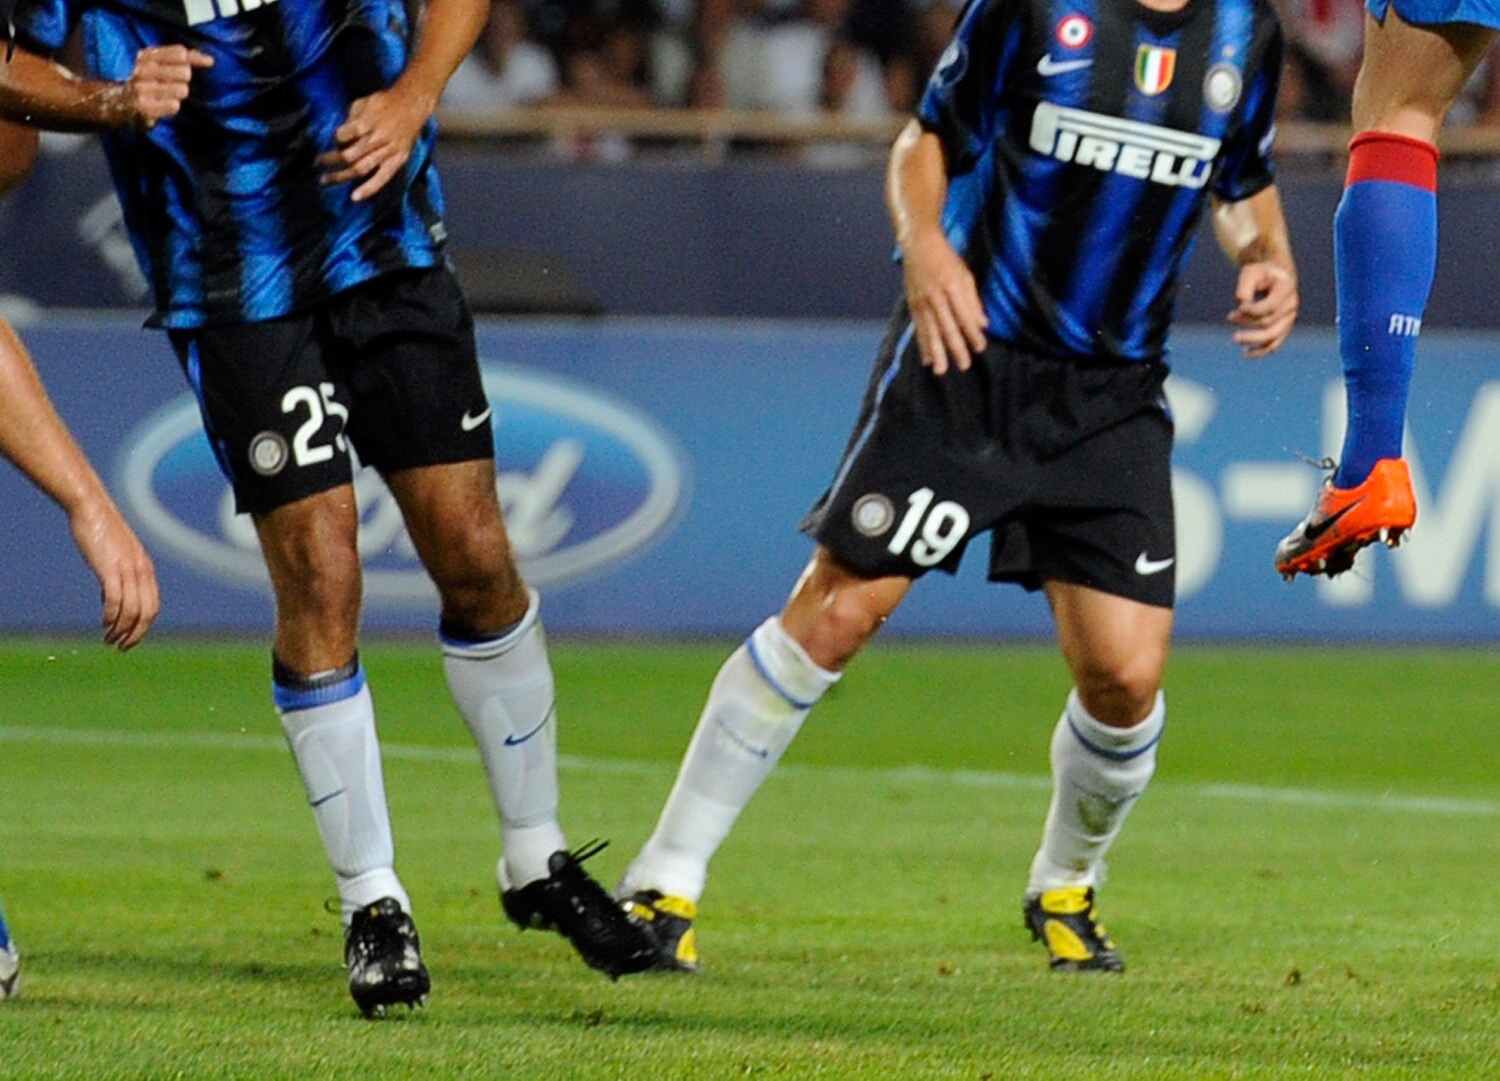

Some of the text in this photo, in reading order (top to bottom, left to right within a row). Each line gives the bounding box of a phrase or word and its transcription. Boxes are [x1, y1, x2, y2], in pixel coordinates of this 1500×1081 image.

[1028, 100, 1223, 190] PIRELLI
[281, 381, 350, 468] 25
[886, 485, 971, 567] 19
